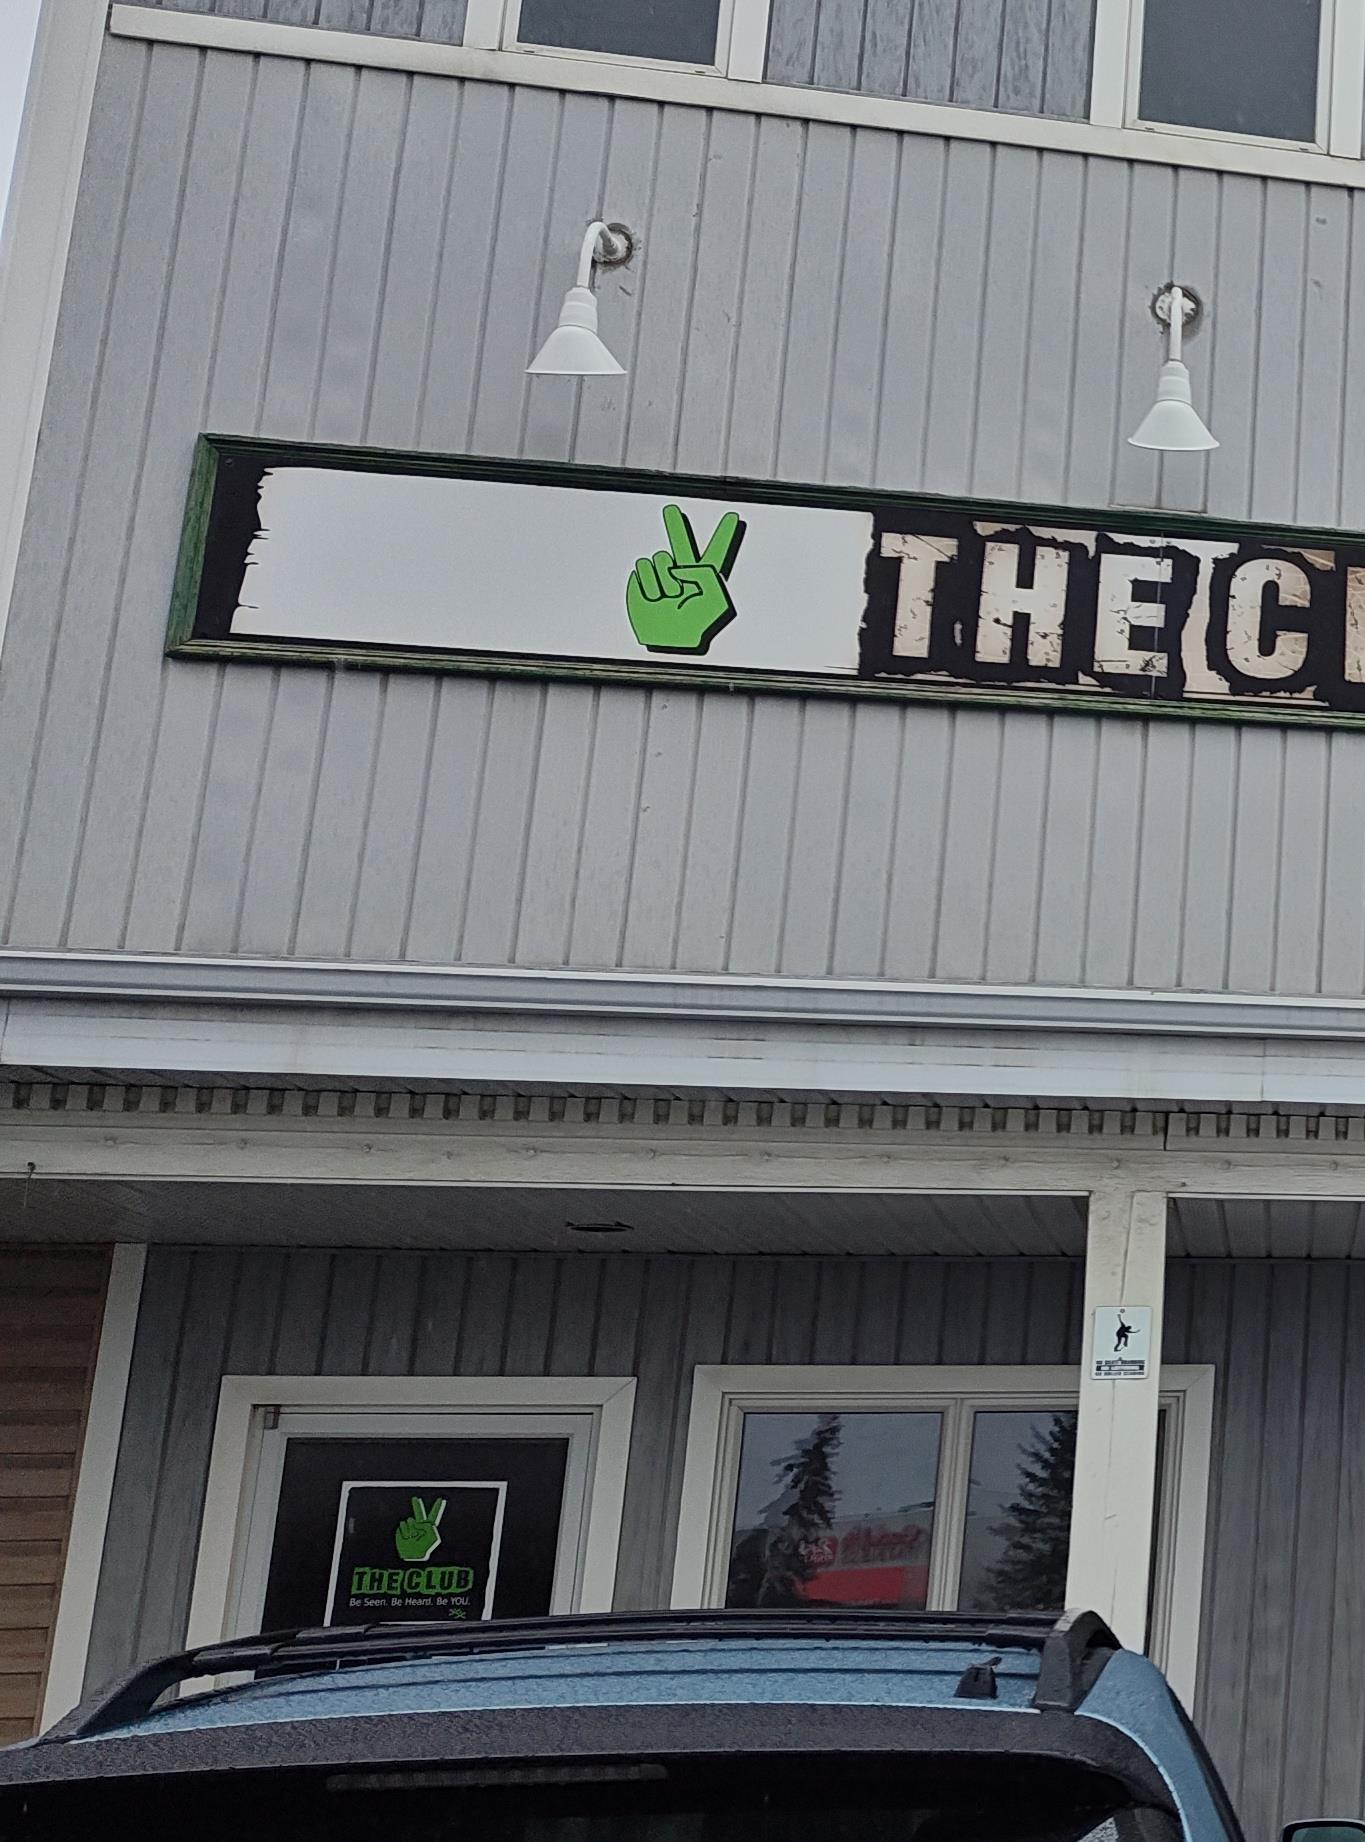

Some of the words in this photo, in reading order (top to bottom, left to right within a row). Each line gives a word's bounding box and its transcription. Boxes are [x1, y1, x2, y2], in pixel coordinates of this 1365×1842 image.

[880, 532, 1174, 678] THE
[354, 1570, 402, 1592] THE
[406, 1569, 471, 1591] CLUB
[350, 1597, 361, 1607] Be
[364, 1598, 388, 1607] Seen.
[391, 1597, 402, 1606] Be
[405, 1597, 433, 1606] Heard.
[436, 1597, 448, 1606] Be
[450, 1596, 471, 1606] YOU.
